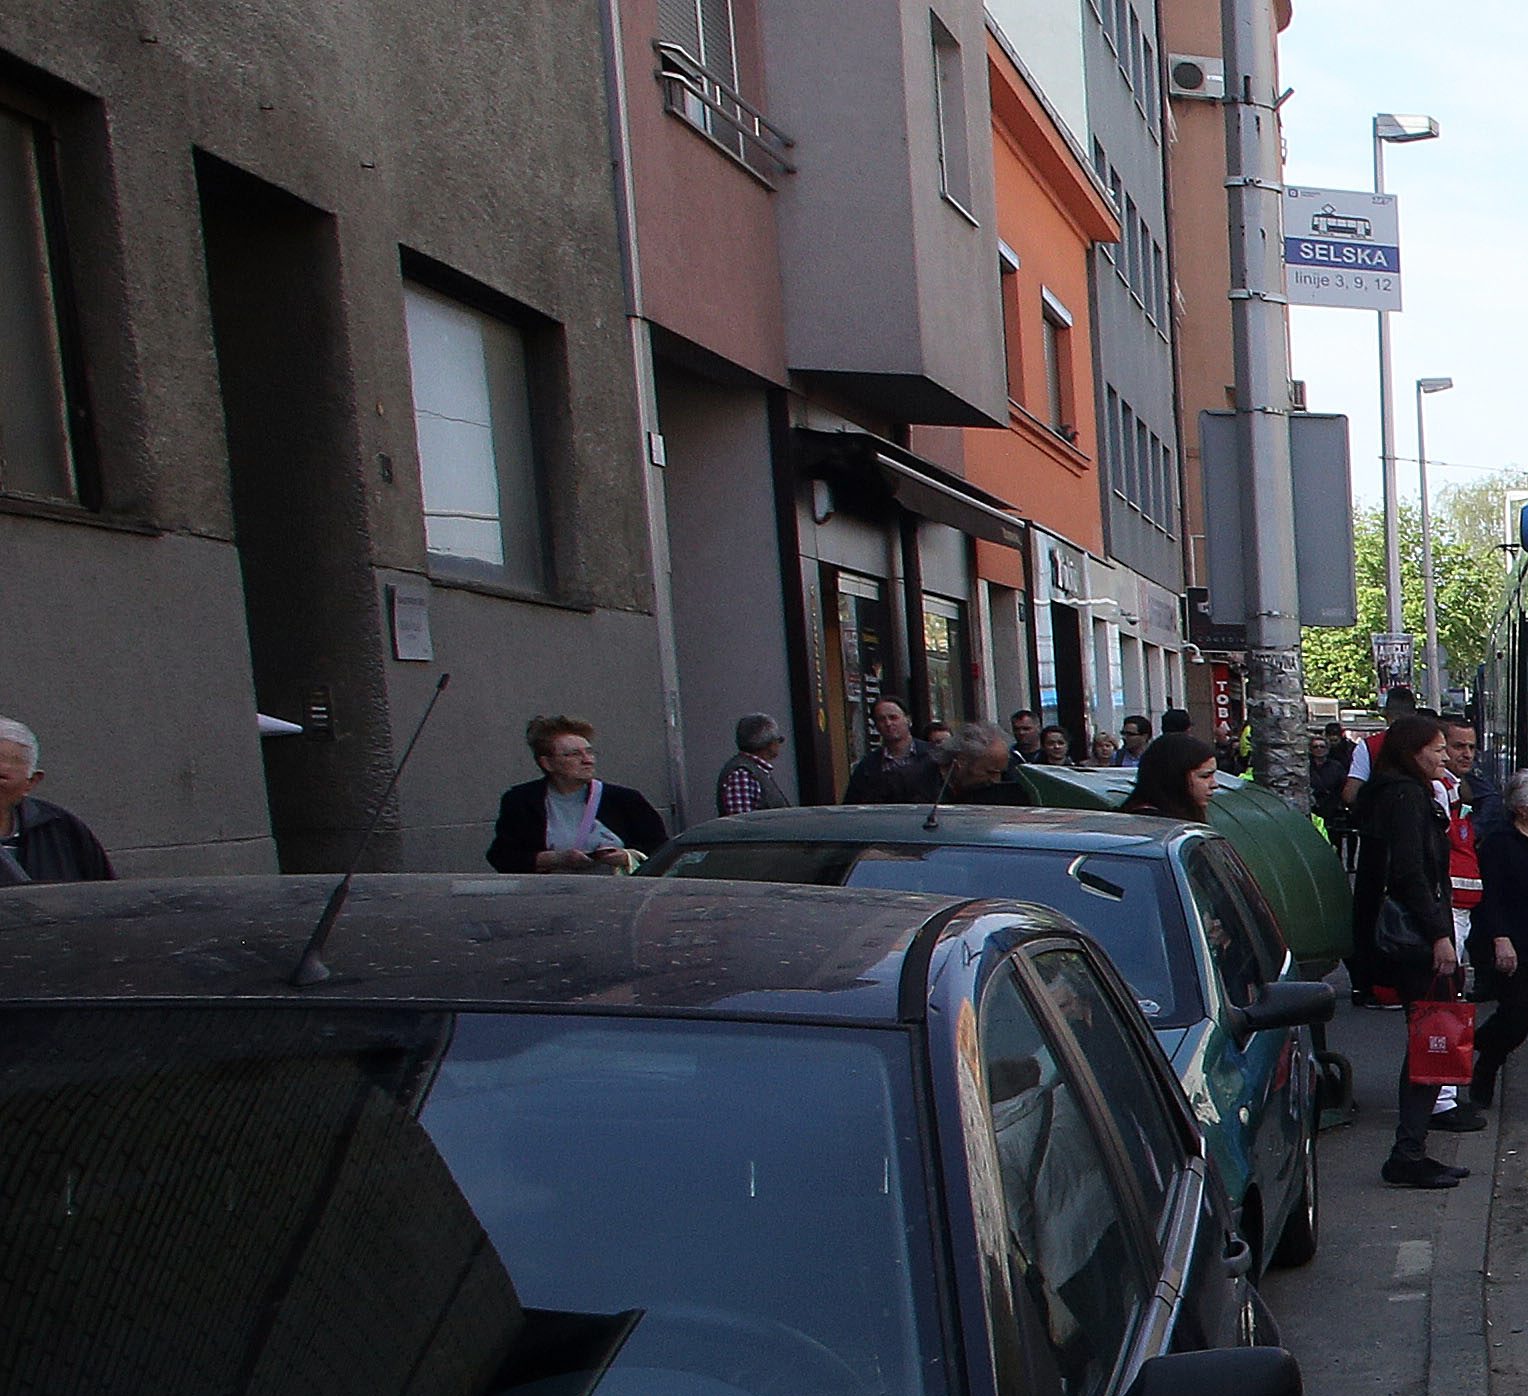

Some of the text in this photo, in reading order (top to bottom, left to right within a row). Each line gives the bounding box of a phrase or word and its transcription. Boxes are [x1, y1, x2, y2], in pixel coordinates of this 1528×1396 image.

[1299, 242, 1388, 267] SELSKA
[1295, 271, 1392, 292] linije 3, 9, 12
